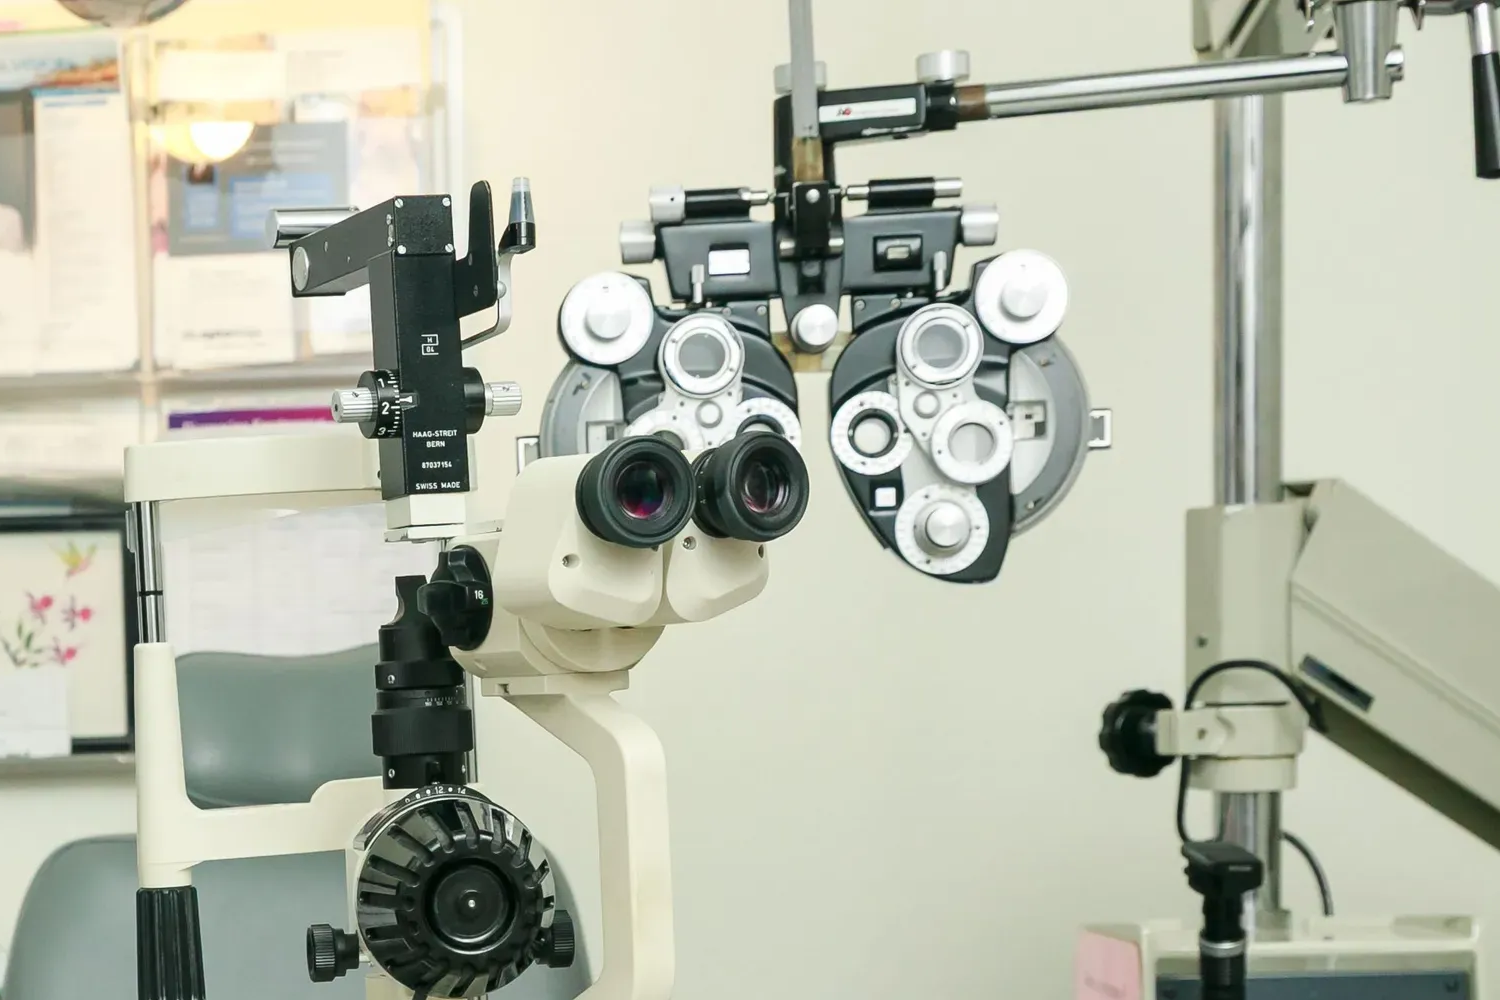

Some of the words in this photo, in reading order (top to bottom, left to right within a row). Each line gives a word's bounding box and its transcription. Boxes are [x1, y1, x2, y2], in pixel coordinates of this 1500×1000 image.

[377, 378, 385, 388] 1
[381, 401, 390, 415] 2
[377, 426, 387, 436] 3
[412, 429, 457, 438] HAAG-STREIT
[426, 440, 445, 448] BERN
[415, 482, 438, 490] SWISS
[440, 481, 460, 489] MADE
[434, 785, 444, 794] 12
[457, 787, 466, 795] 14
